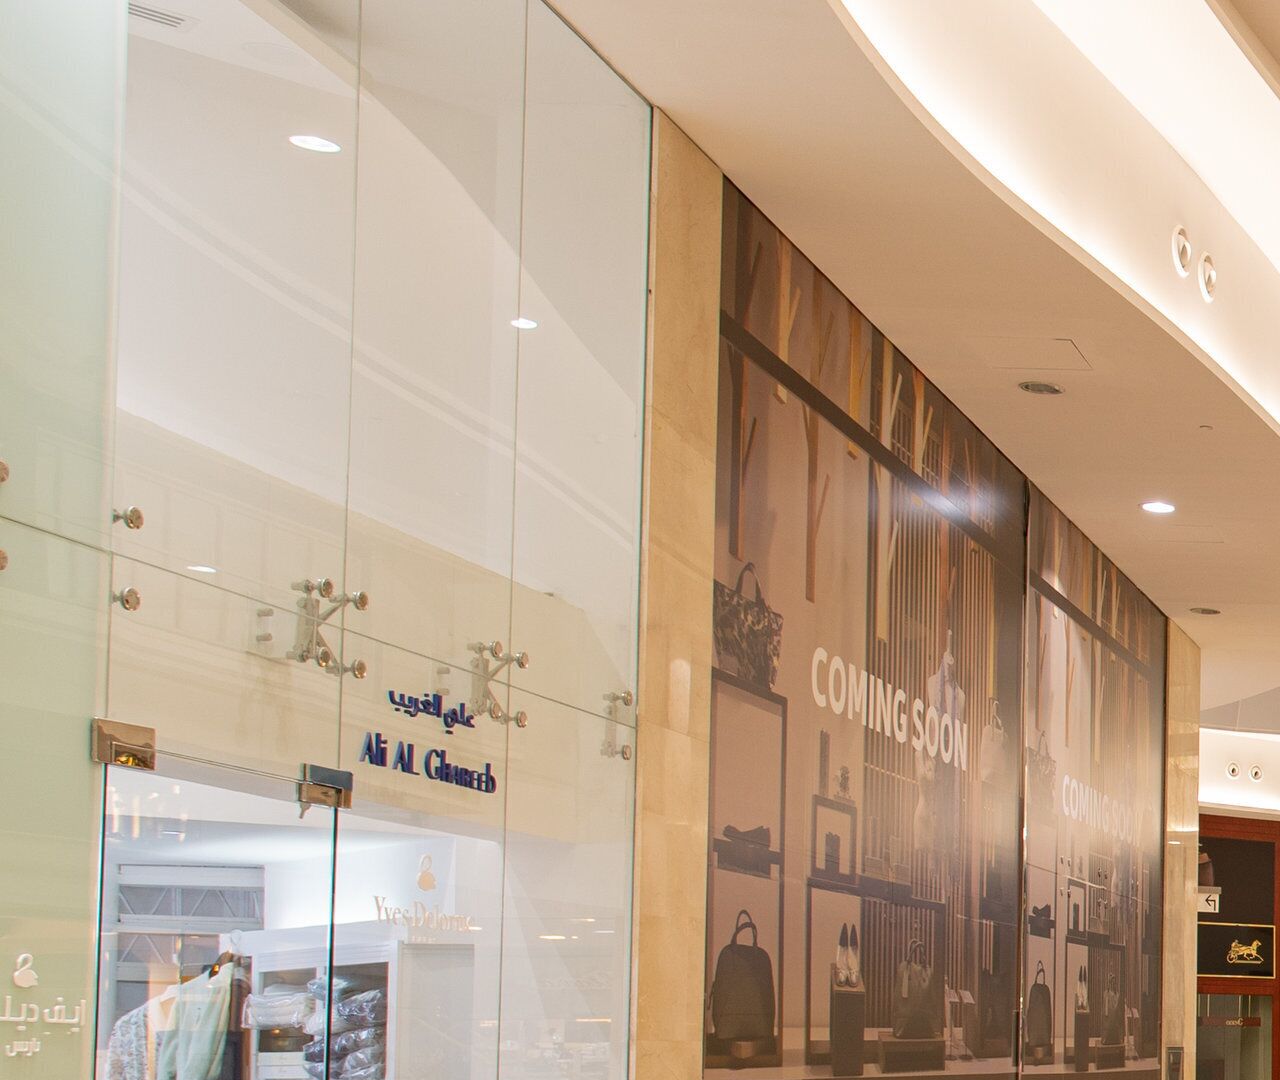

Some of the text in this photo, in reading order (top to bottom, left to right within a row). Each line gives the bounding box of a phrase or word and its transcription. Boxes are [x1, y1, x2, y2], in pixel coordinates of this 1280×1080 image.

[388, 690, 475, 734] علي الغريب
[811, 647, 967, 771] COMING SOON
[359, 732, 387, 767] Ali
[1062, 774, 1143, 847] COMING SOON
[374, 895, 409, 928] Yves
